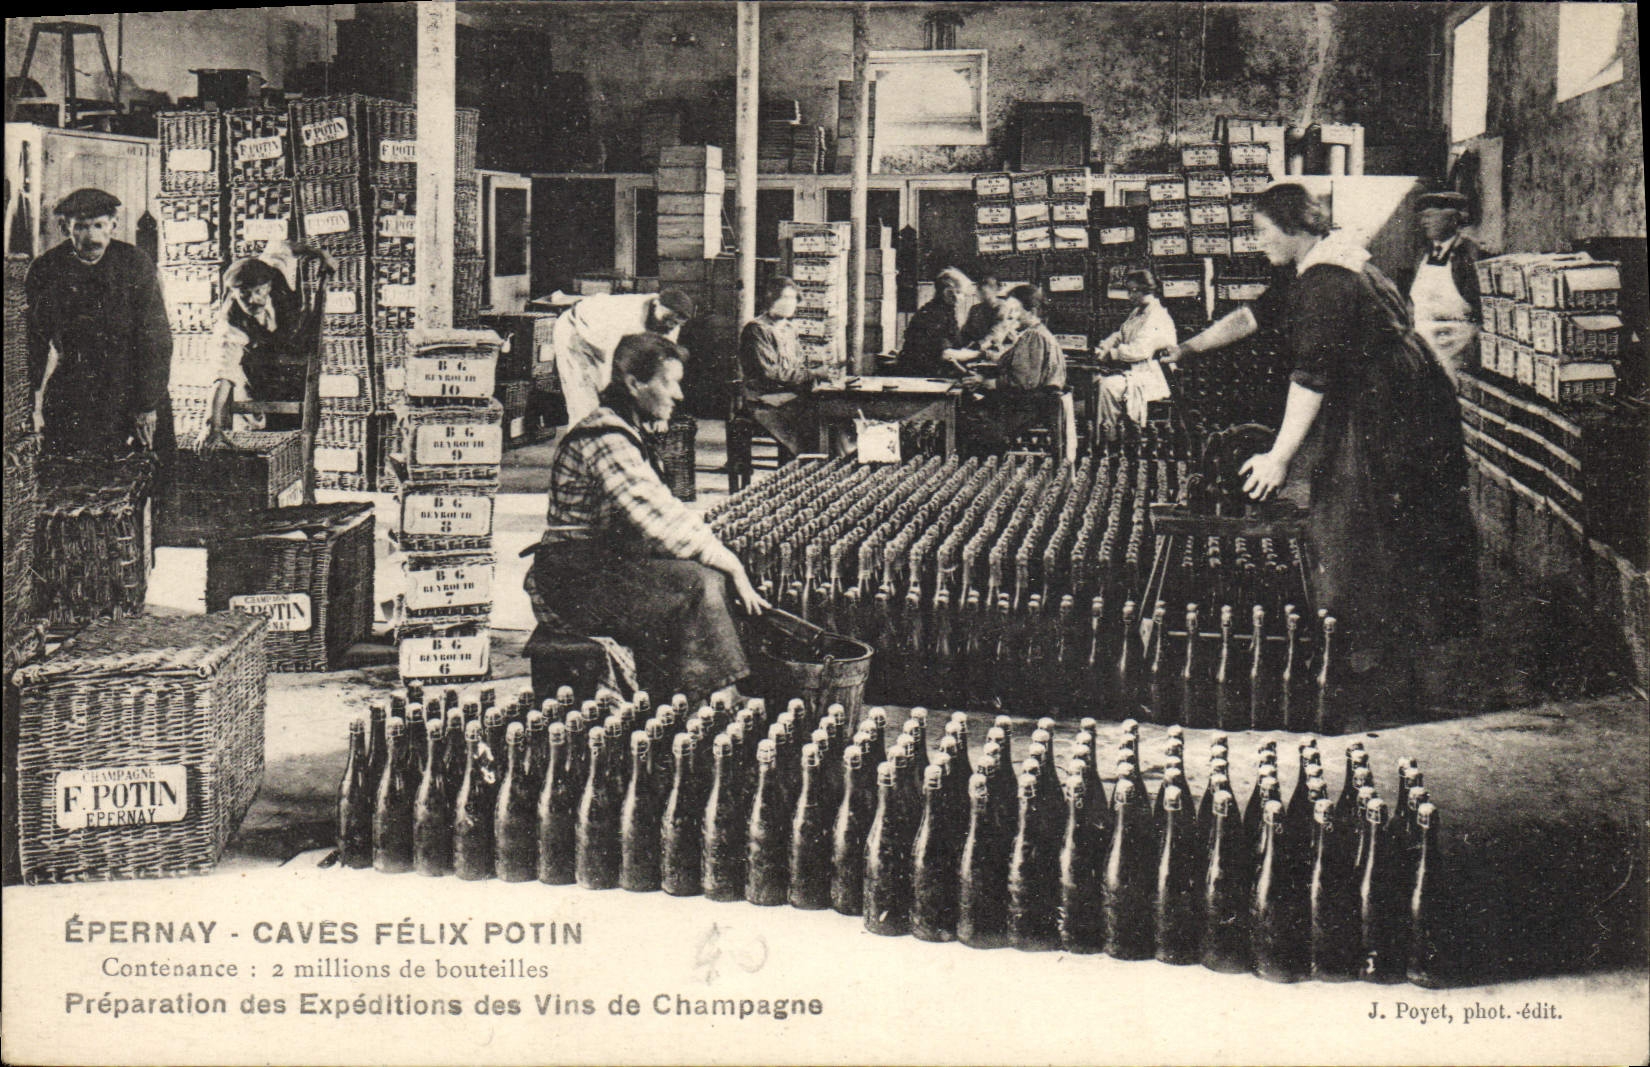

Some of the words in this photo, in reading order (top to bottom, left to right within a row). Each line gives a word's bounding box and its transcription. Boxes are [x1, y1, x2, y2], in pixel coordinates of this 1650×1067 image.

[392, 145, 416, 156] POTI
[441, 383, 461, 396] 10
[452, 449, 462, 461] 9
[440, 520, 452, 533] 8
[439, 663, 450, 675] 6
[82, 768, 156, 783] CHAMPAGNE
[64, 785, 86, 813] F.
[92, 781, 177, 811] POTIN
[86, 808, 156, 828] EPERNAY
